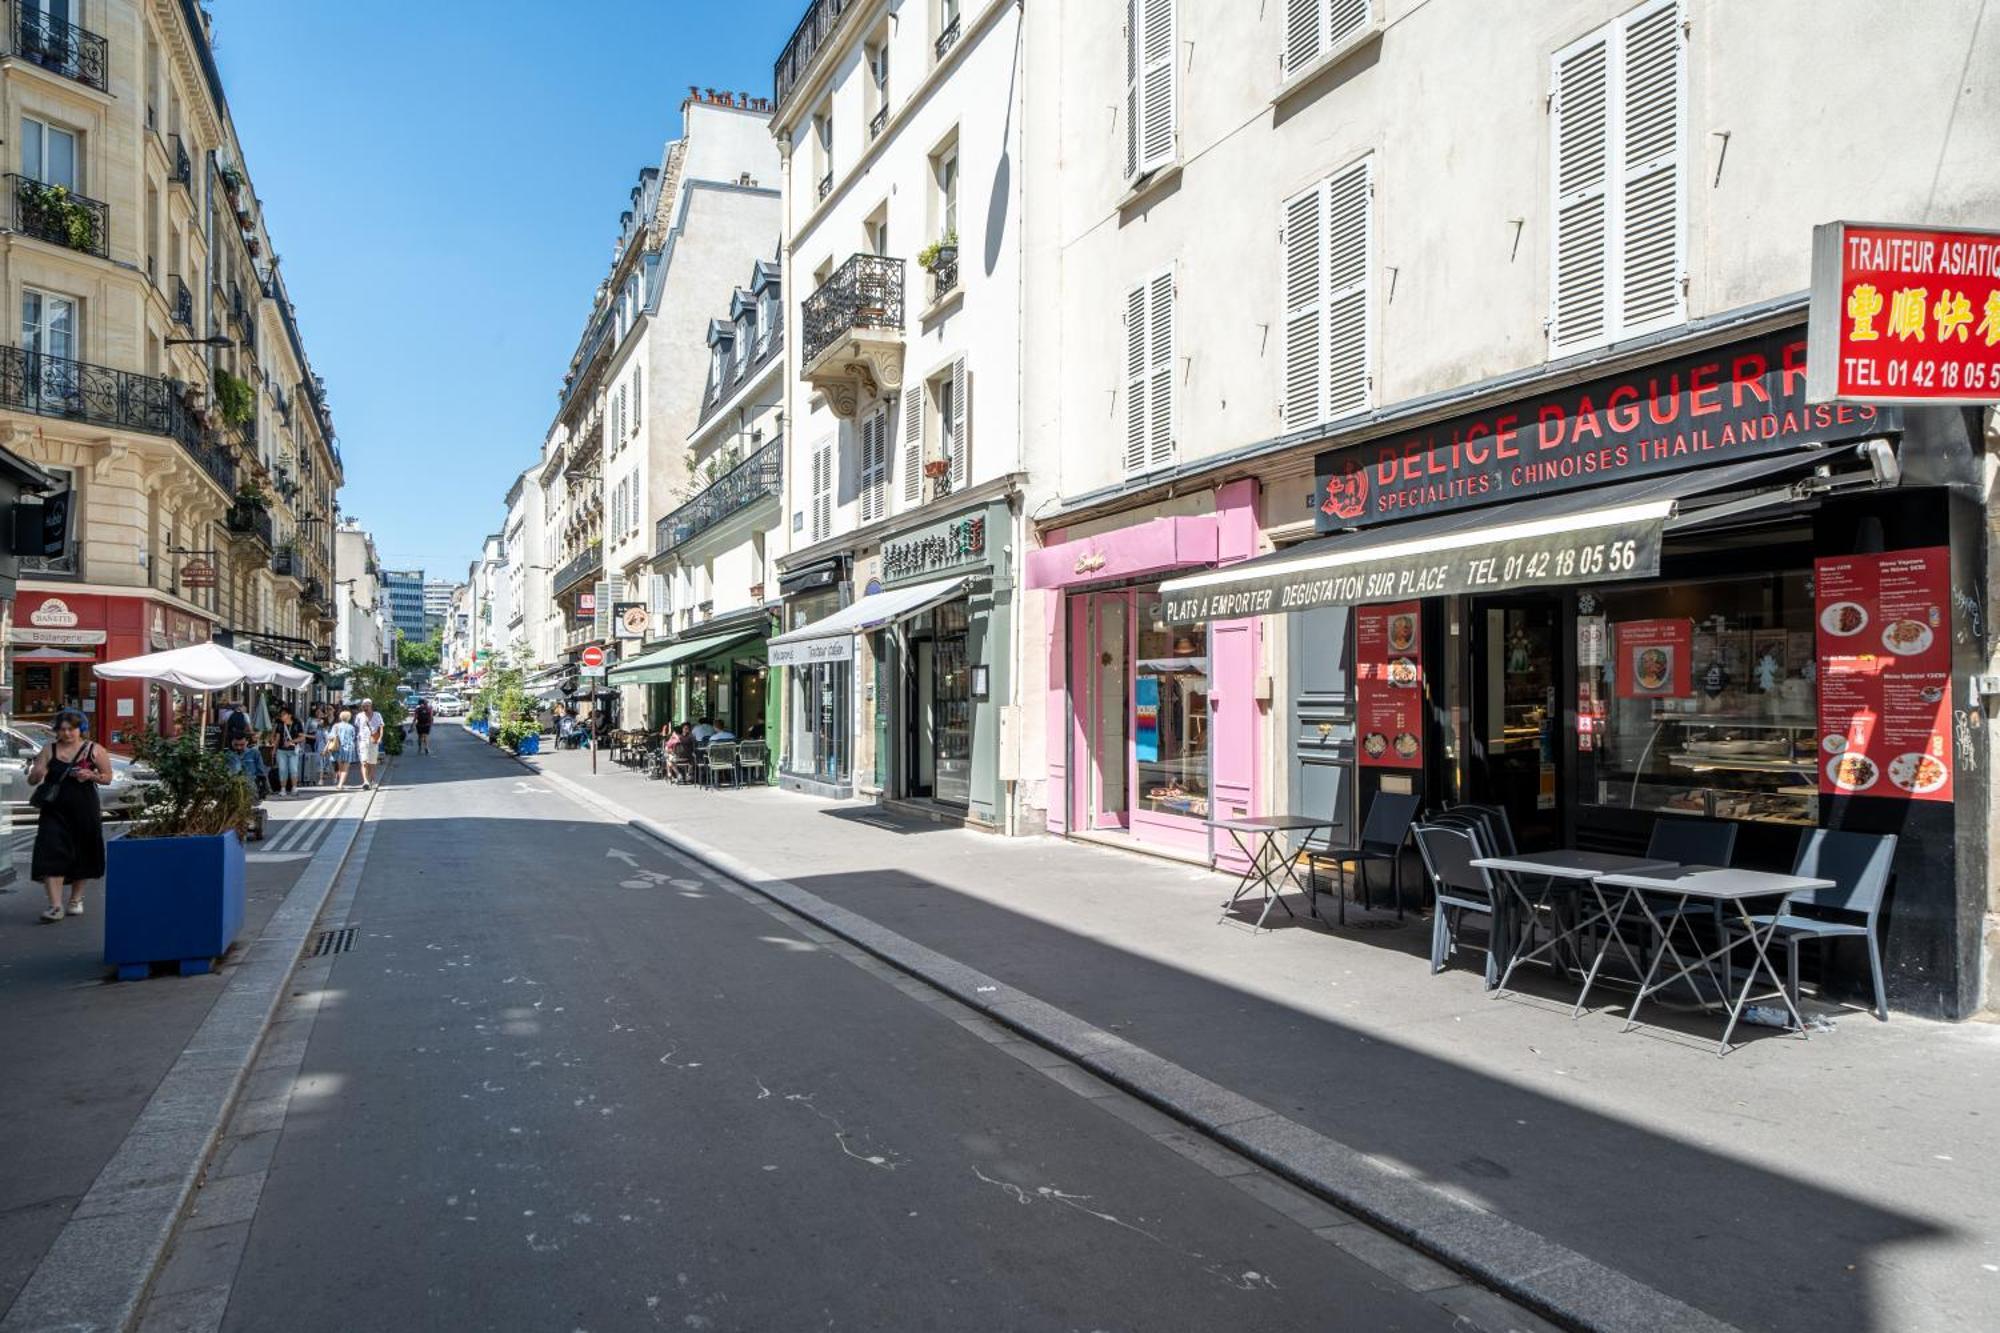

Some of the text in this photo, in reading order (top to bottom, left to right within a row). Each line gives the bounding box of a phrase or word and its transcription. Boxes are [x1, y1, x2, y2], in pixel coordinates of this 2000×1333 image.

[1849, 237, 1934, 273] TRAITEUR
[1845, 358, 1881, 386] TEL
[1887, 360, 1908, 386] 01
[1912, 361, 1935, 387] 42
[1941, 361, 1958, 388] 18
[1964, 362, 1985, 389] 05
[1378, 415, 1520, 486] DELICE
[1378, 475, 1489, 512] SPECIALITES
[1511, 446, 1629, 487] CHINOISES
[1167, 540, 1636, 621] PLATS A EMPORTER DEGUSTATION SUR PLACE TEL 01 42 18 05 56
[32, 632, 83, 643] Boulangerie
